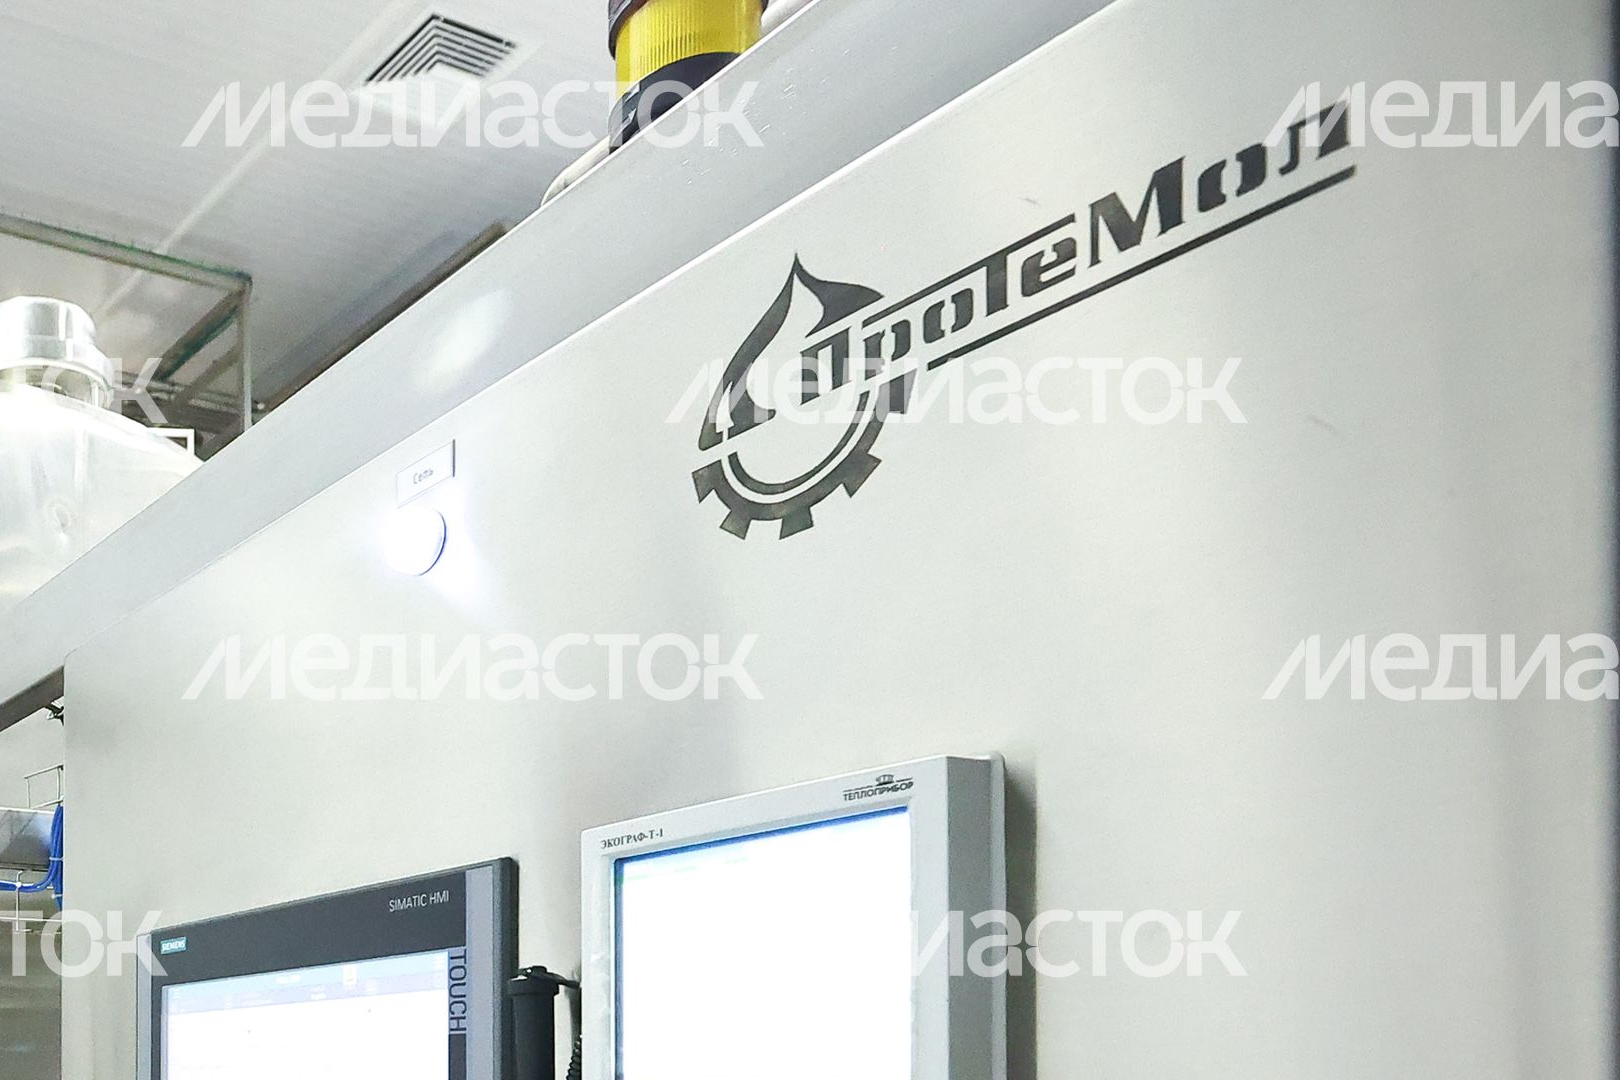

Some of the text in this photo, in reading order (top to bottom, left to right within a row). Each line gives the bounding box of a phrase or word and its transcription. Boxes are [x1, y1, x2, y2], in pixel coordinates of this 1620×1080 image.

[600, 828, 664, 849] ЭКОГРАФ-Т-1
[389, 890, 449, 913] SIMATIC HMI
[162, 939, 186, 952] SIEMENS
[449, 949, 467, 1034] TOUCH
